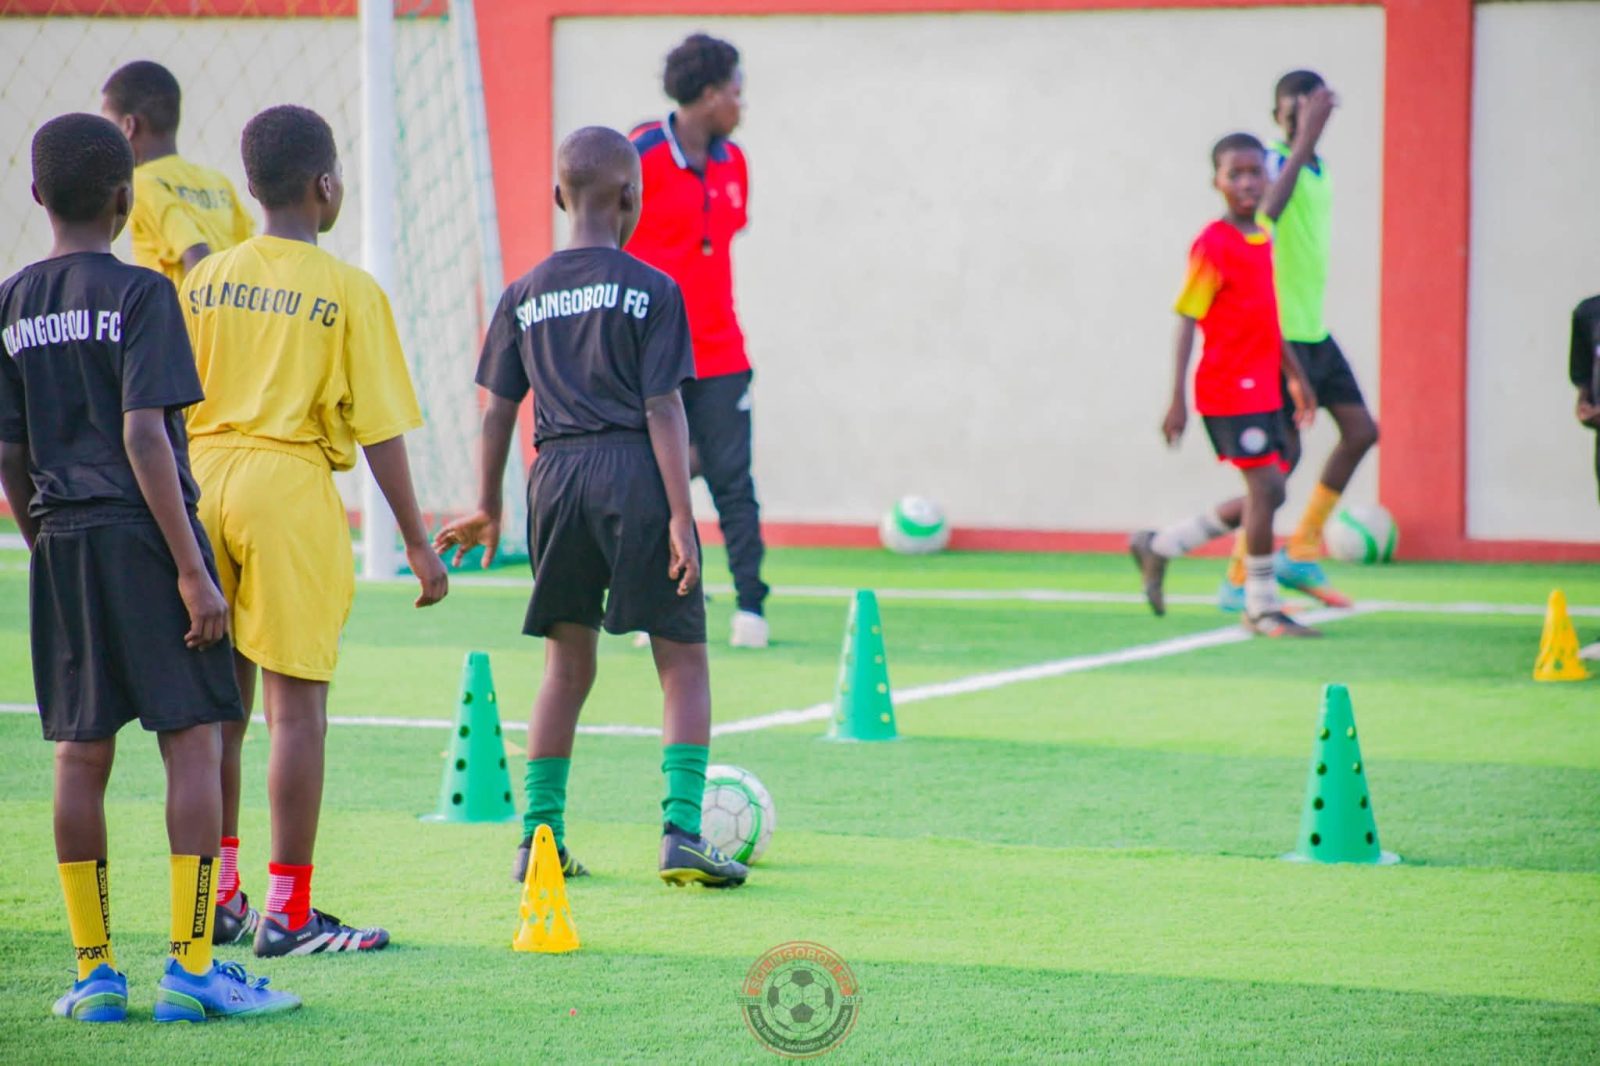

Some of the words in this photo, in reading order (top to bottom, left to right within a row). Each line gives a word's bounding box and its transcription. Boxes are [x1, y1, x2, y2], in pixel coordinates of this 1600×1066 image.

[309, 297, 339, 327] FC
[623, 287, 649, 319] FC
[96, 310, 121, 342] FC
[199, 864, 210, 894] SOCKS
